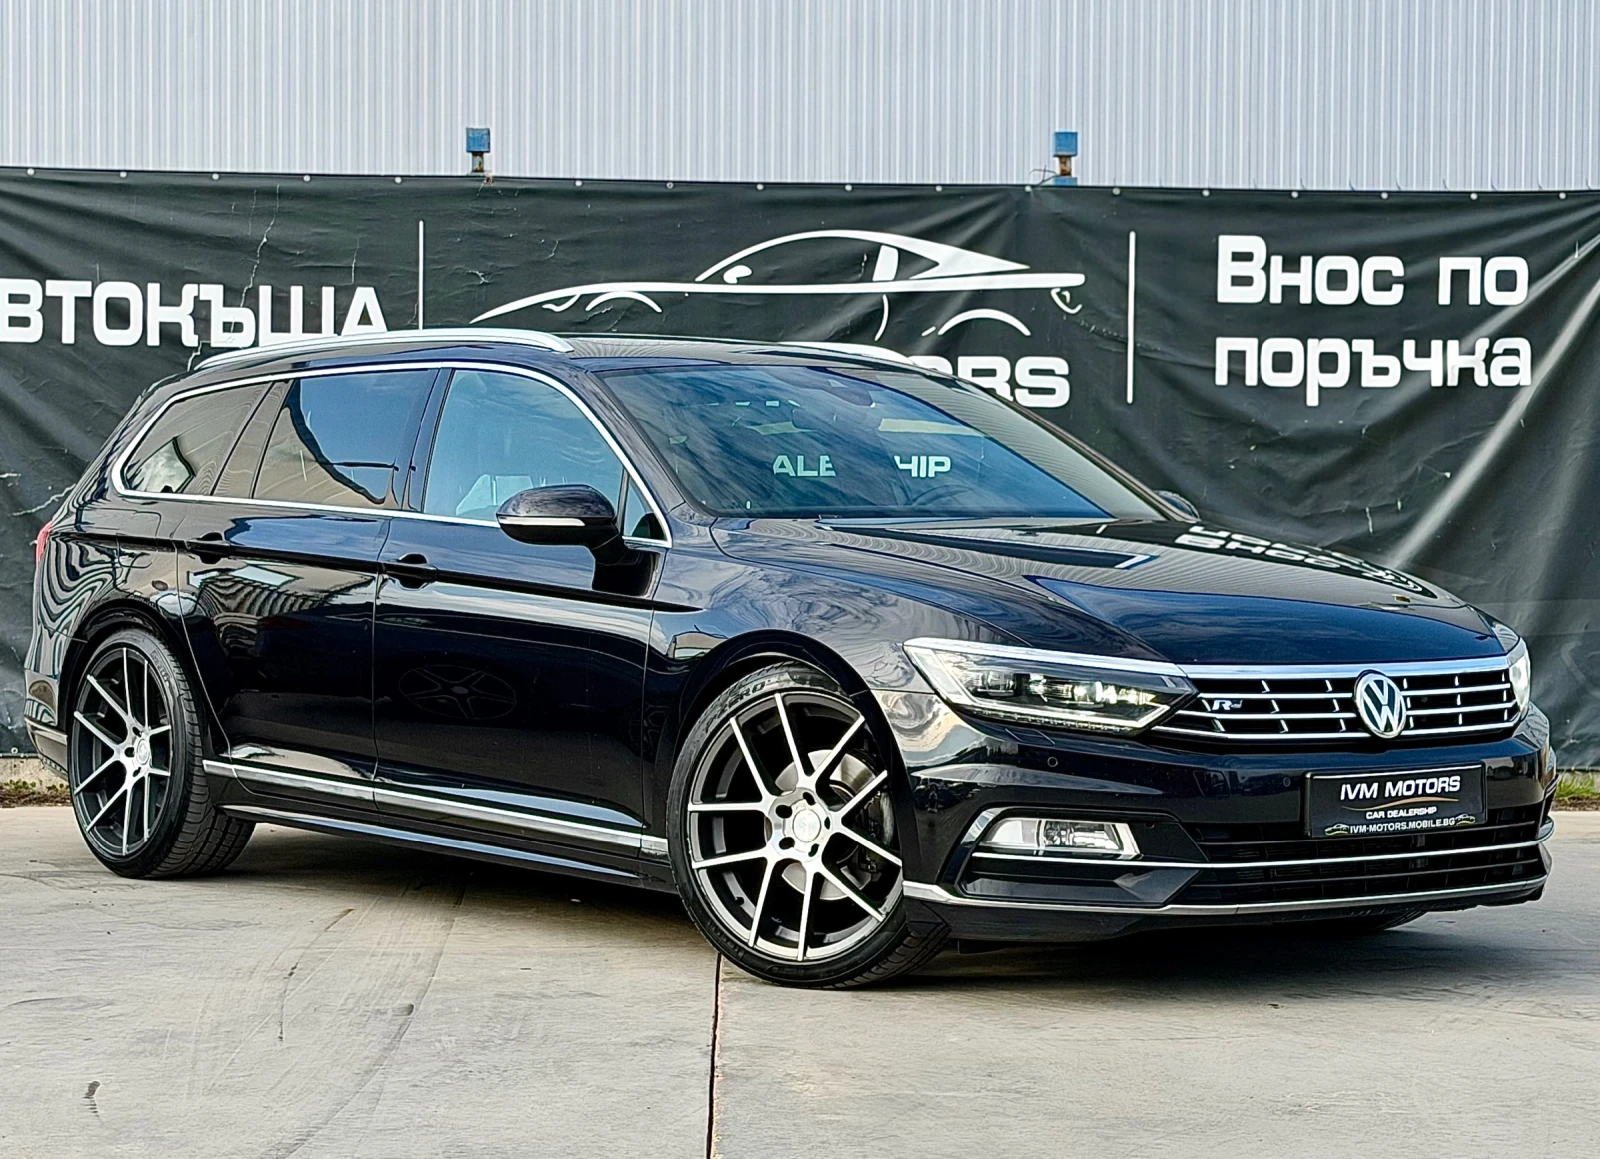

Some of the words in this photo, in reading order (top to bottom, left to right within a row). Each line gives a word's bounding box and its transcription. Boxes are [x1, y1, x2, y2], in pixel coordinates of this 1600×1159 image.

[1217, 235, 1405, 305] Внос
[1438, 256, 1529, 306] по
[1215, 337, 1532, 406] поръчка
[1340, 782, 1379, 801] IVM
[1384, 775, 1461, 798] MOTORS
[1365, 810, 1386, 820] CAR
[1386, 806, 1438, 819] DEALERSHIP
